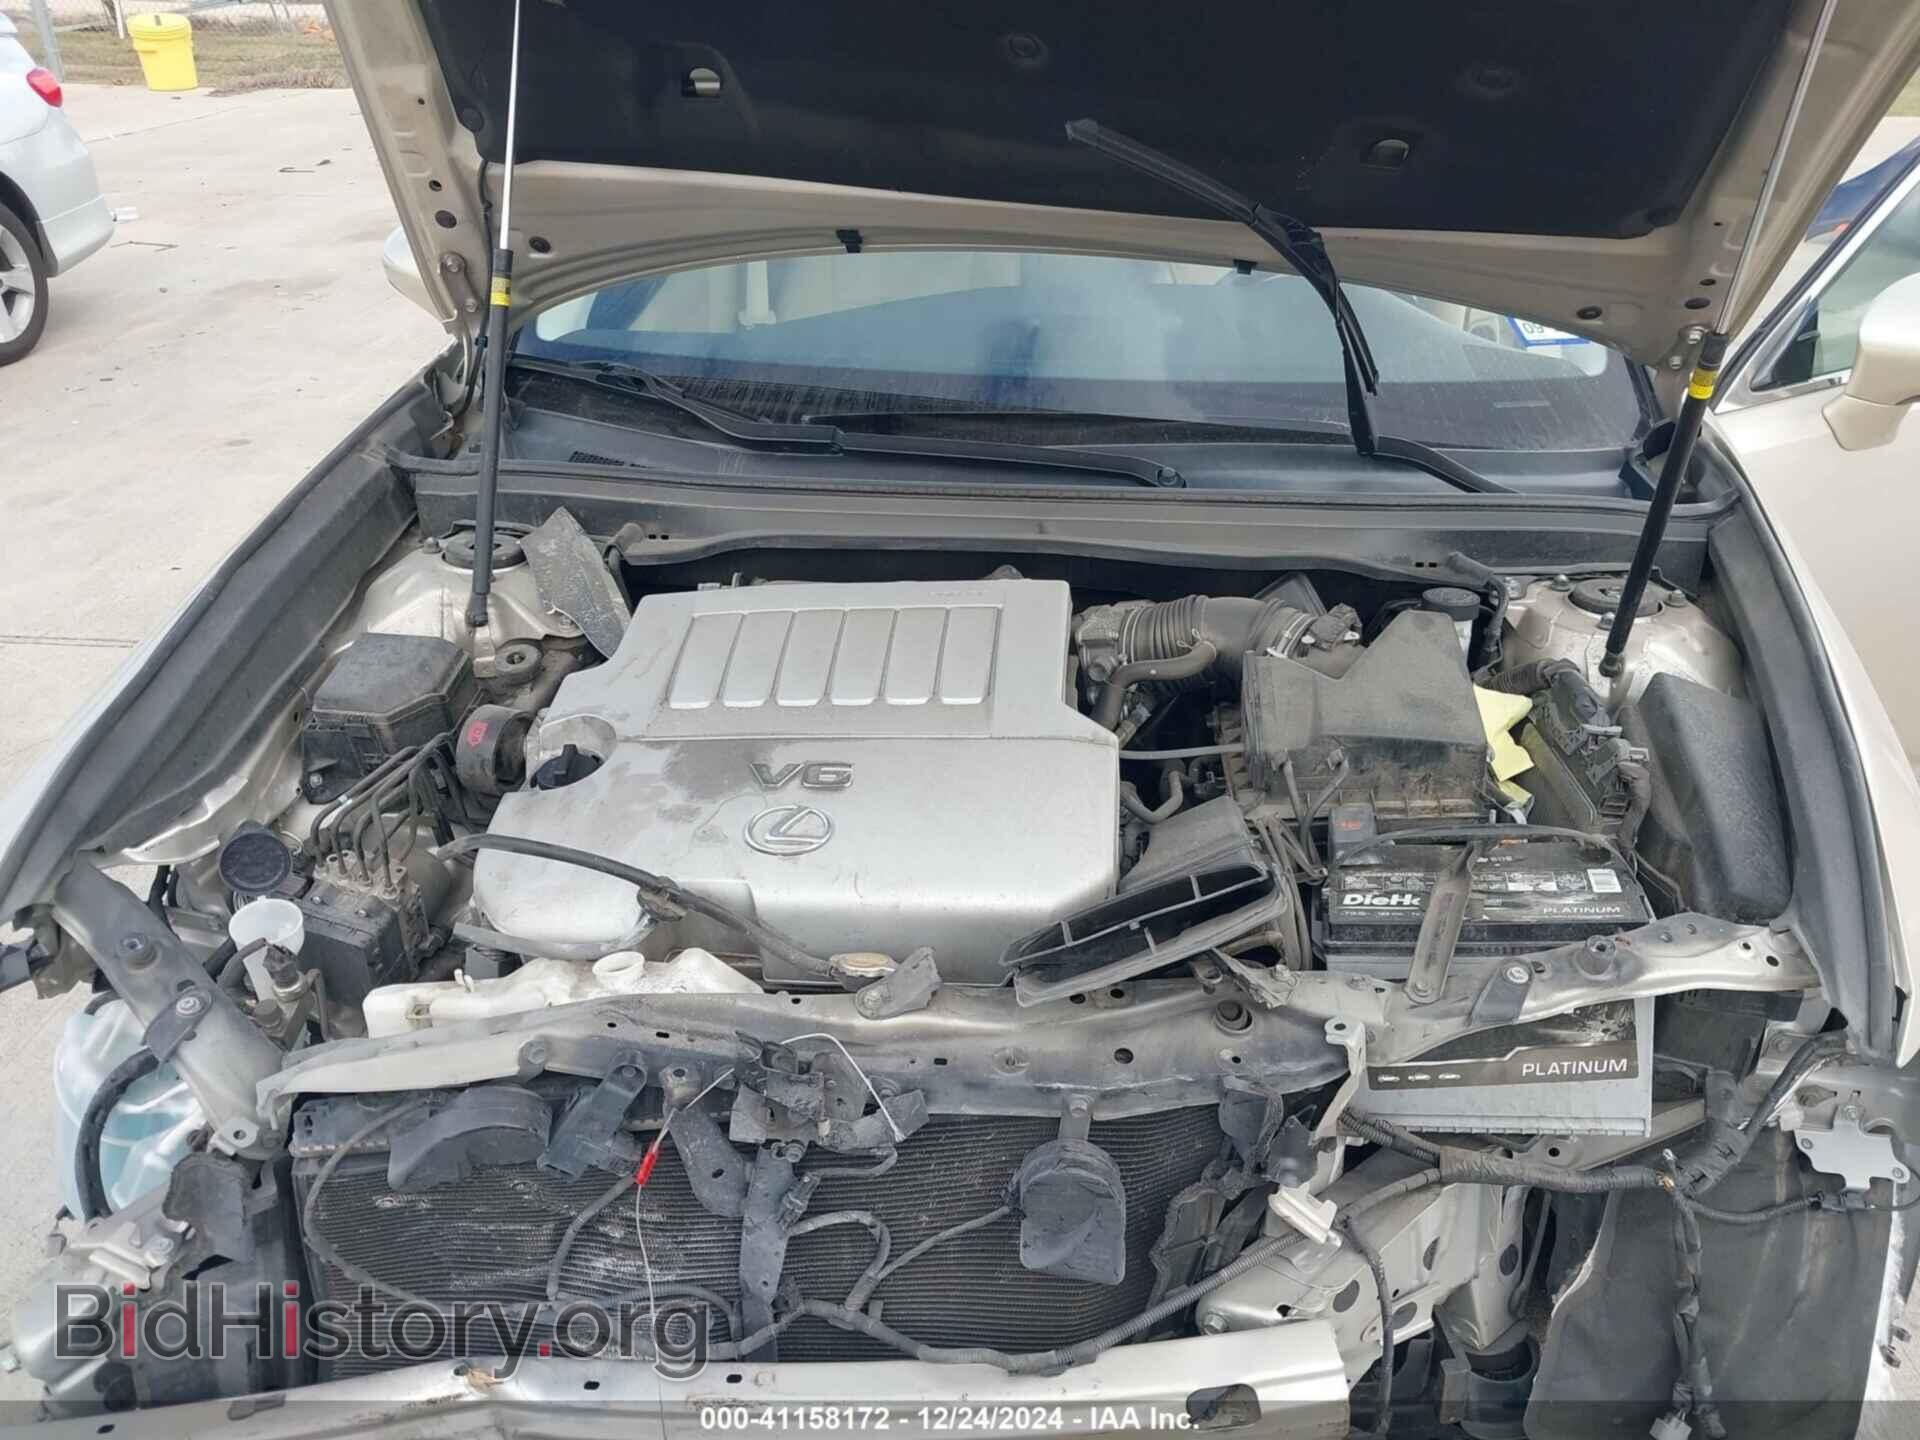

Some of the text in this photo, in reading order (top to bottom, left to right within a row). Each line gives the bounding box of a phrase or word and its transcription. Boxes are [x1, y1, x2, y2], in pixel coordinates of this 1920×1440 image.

[748, 761, 855, 790] V6
[1543, 906, 1621, 915] PLATINUM
[1522, 1058, 1628, 1077] PLATINUM
